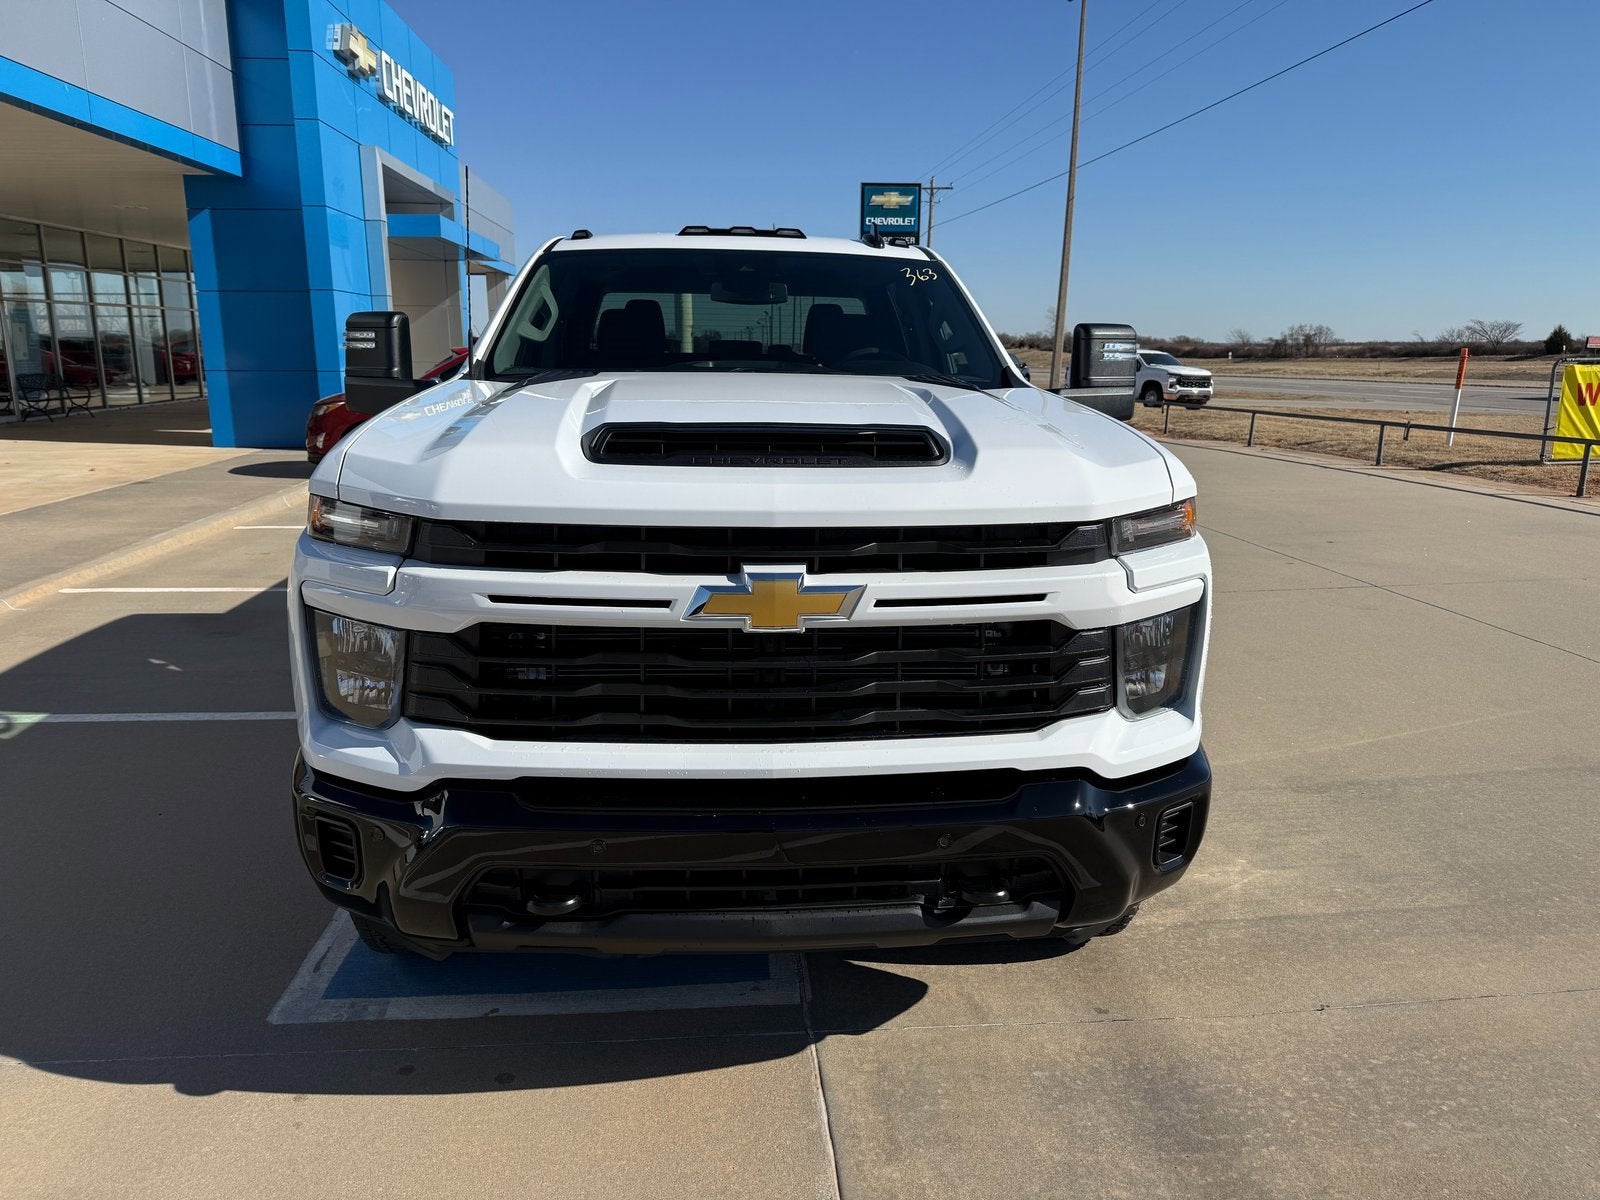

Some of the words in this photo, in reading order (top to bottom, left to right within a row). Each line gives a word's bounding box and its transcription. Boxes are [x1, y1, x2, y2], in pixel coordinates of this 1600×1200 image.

[379, 50, 455, 147] CHEVROLET
[865, 217, 916, 226] CHEVROLET
[900, 267, 938, 286] 363
[692, 455, 848, 465] CHEVROLET
